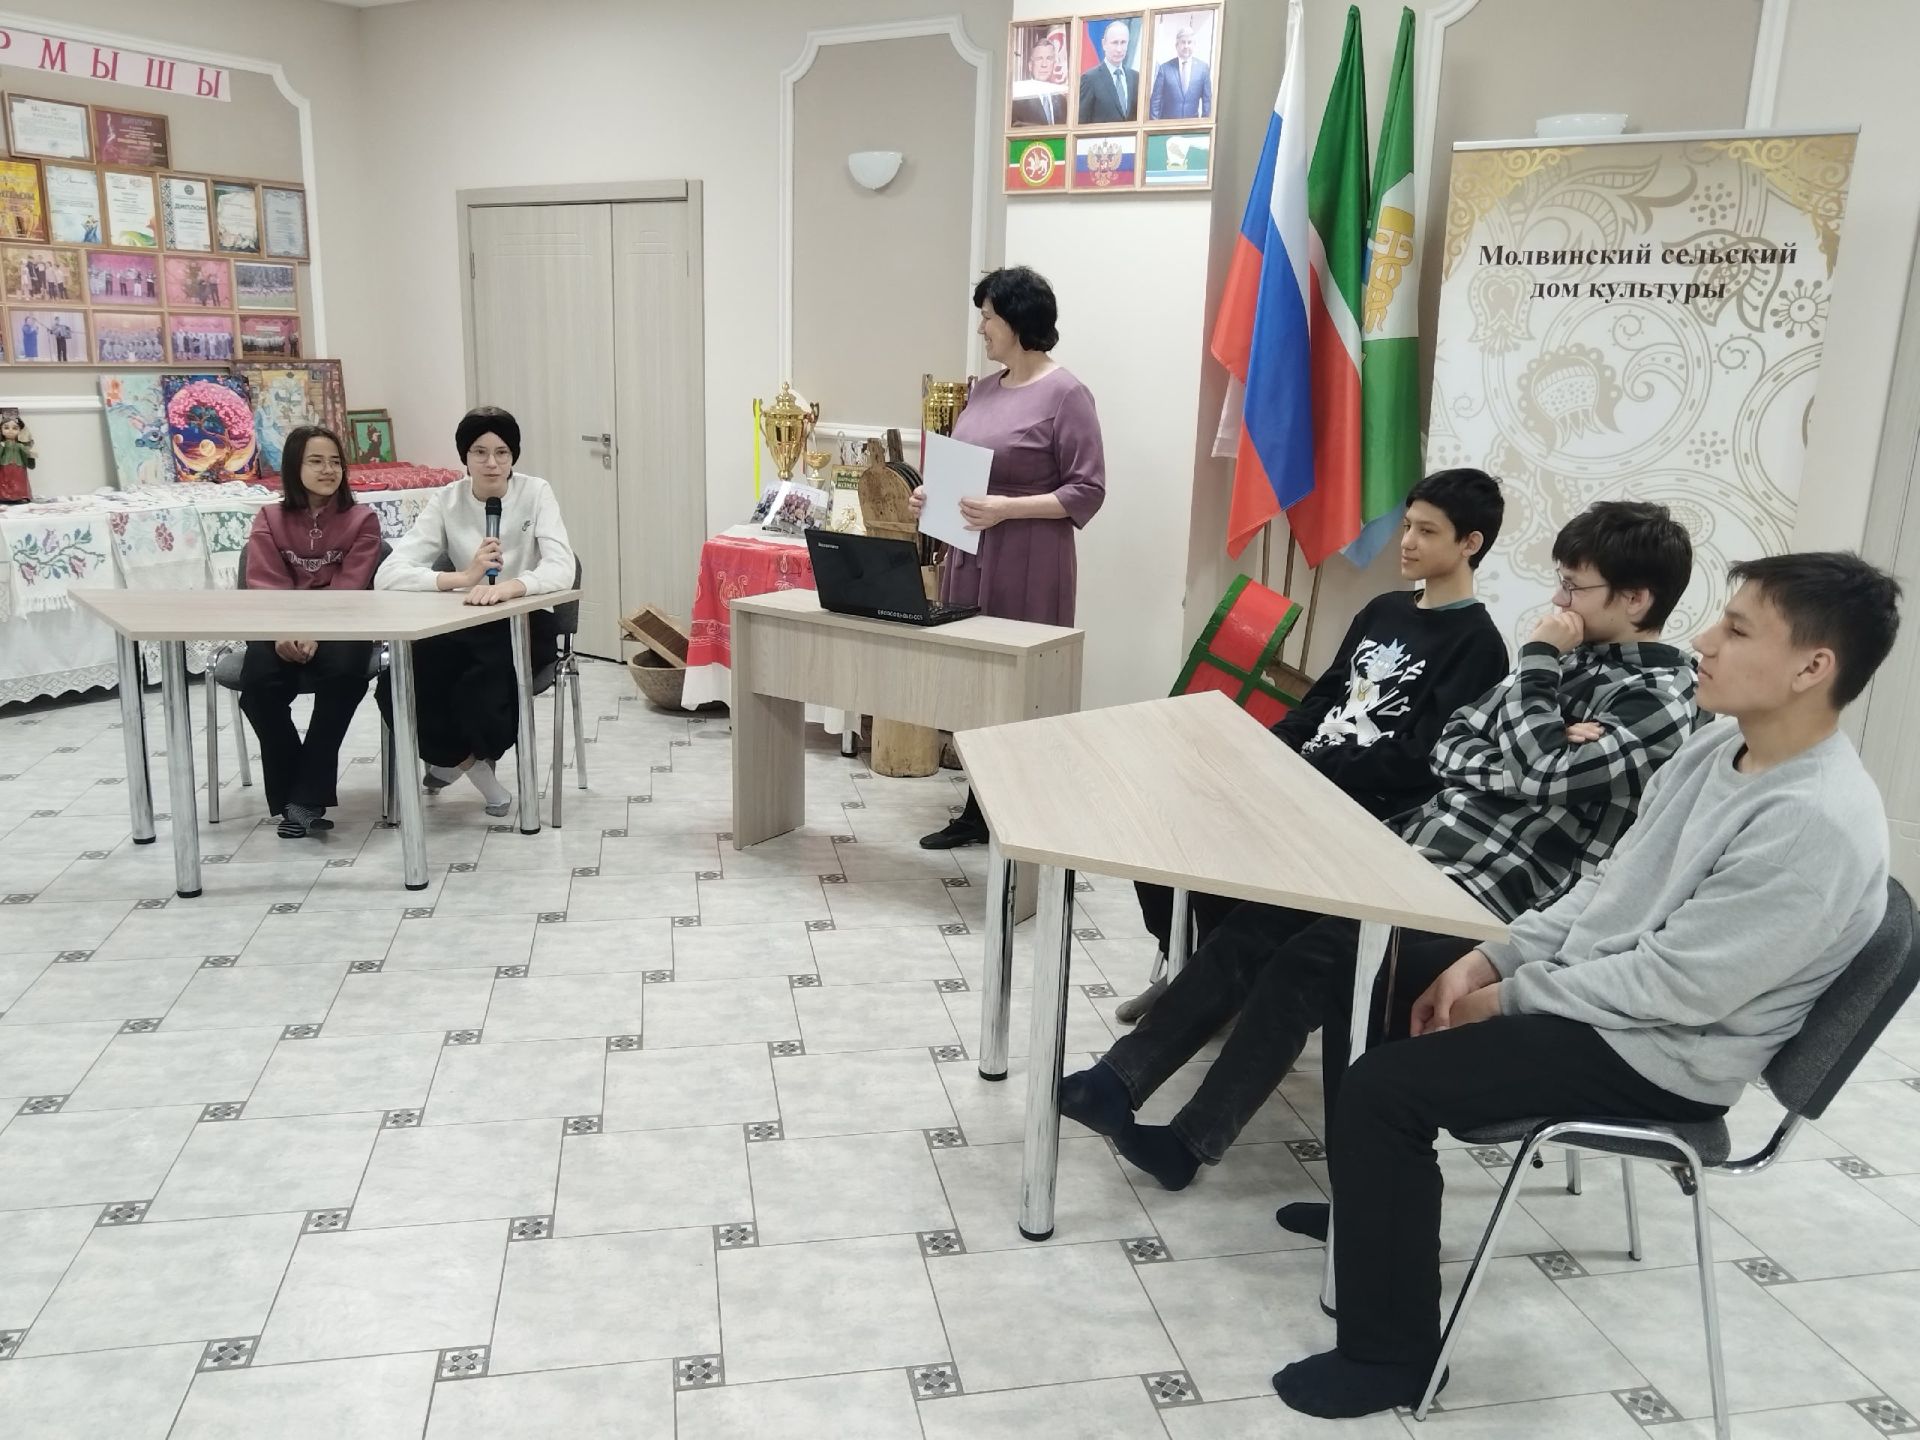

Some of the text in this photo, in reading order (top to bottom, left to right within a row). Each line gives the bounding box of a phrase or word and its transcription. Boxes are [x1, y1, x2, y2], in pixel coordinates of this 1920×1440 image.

[174, 202, 207, 211] ДИПЛОМ
[1478, 242, 1797, 266] Молвинский сельский
[1530, 282, 1727, 304] дом культуры
